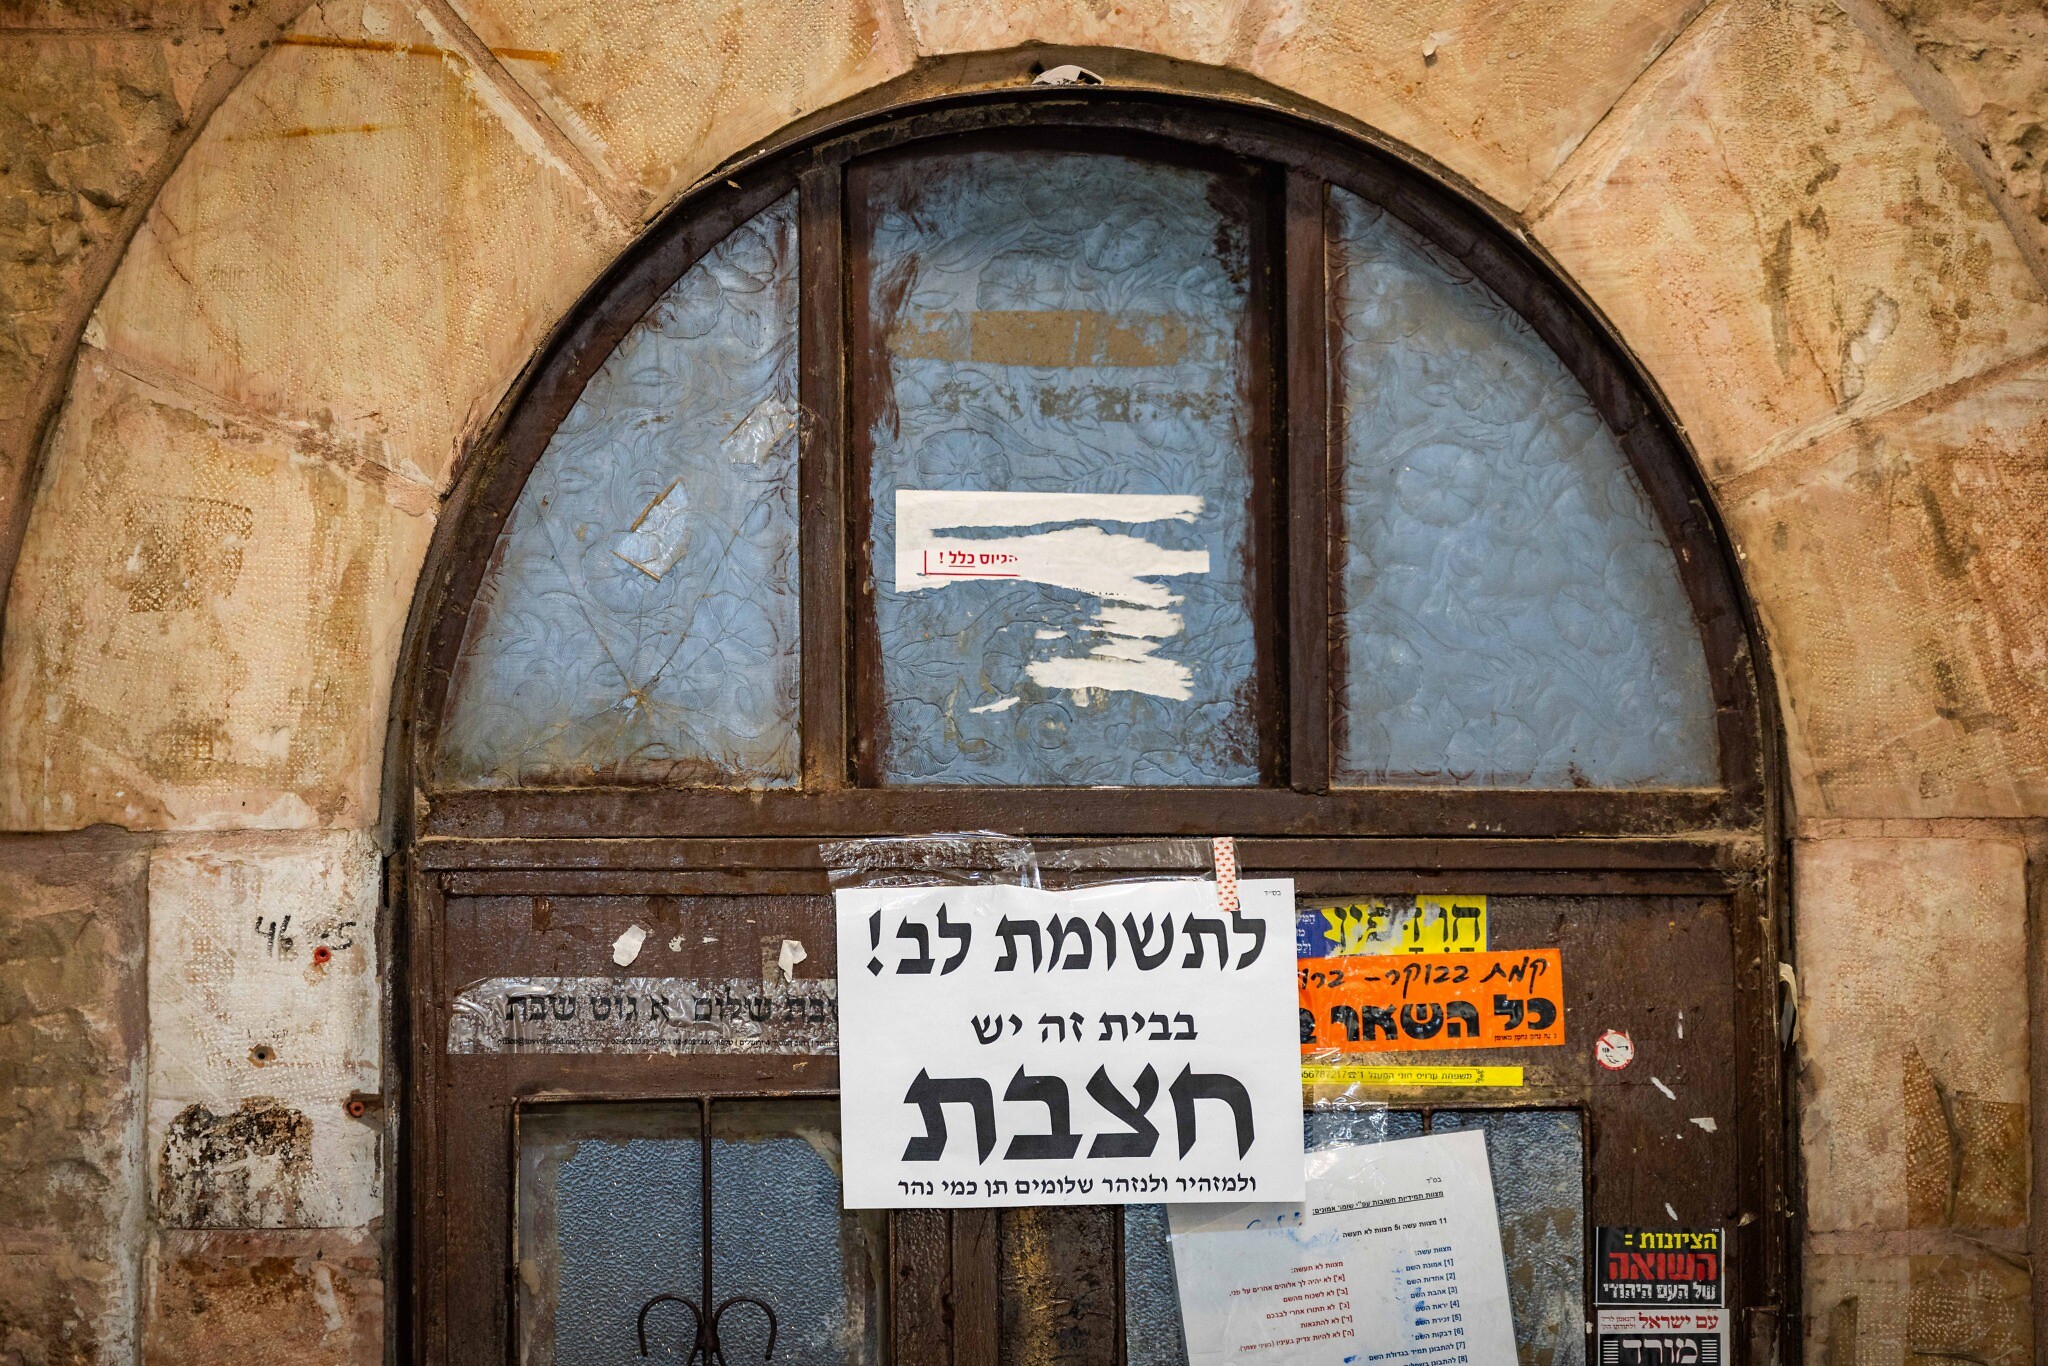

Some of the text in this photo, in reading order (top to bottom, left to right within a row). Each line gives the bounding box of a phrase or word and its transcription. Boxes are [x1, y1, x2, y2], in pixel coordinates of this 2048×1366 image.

[948, 551, 975, 564] כלל
[866, 899, 1266, 976] לתשומת לב!
[1298, 968, 1345, 989] ברו
[1480, 957, 1548, 994] קמת
[505, 994, 576, 1021] שבת
[692, 986, 772, 1021] שלום
[1494, 994, 1556, 1031] כל
[1331, 1001, 1480, 1041] השאר
[971, 1011, 1198, 1045] בבית זה יש
[901, 1062, 1255, 1166] חצבת
[898, 1172, 1256, 1199] ולמזהיר ולנזהר שלומים תן כמי נהר
[1425, 1190, 1444, 1199] מצוות
[1402, 1222, 1417, 1230] עשה
[1419, 1219, 1437, 1227] מצוות
[1342, 1230, 1362, 1238] תעשה
[1364, 1227, 1372, 1235] לא
[1374, 1226, 1392, 1234] מצוות
[1639, 1232, 1717, 1249] הציונות
[1433, 1245, 1452, 1254] מצוות
[1315, 1262, 1323, 1270] לא
[1444, 1258, 1454, 1267] [1]
[1609, 1252, 1717, 1280] השואה
[1405, 1264, 1421, 1272] השם
[1323, 1275, 1331, 1283] לא
[1446, 1272, 1456, 1281] [2]
[1326, 1289, 1335, 1297] לא
[1410, 1291, 1426, 1299] השם
[1448, 1286, 1458, 1295] [3]
[1603, 1280, 1716, 1301] של העם היהודי
[1327, 1303, 1335, 1311] לא
[1450, 1299, 1460, 1309] [4]
[1452, 1313, 1462, 1323] [5]
[1638, 1312, 1719, 1330] עם ישראל
[1332, 1330, 1341, 1338] לא
[1622, 1337, 1698, 1364] מורד
[1368, 1353, 1384, 1361] השם
